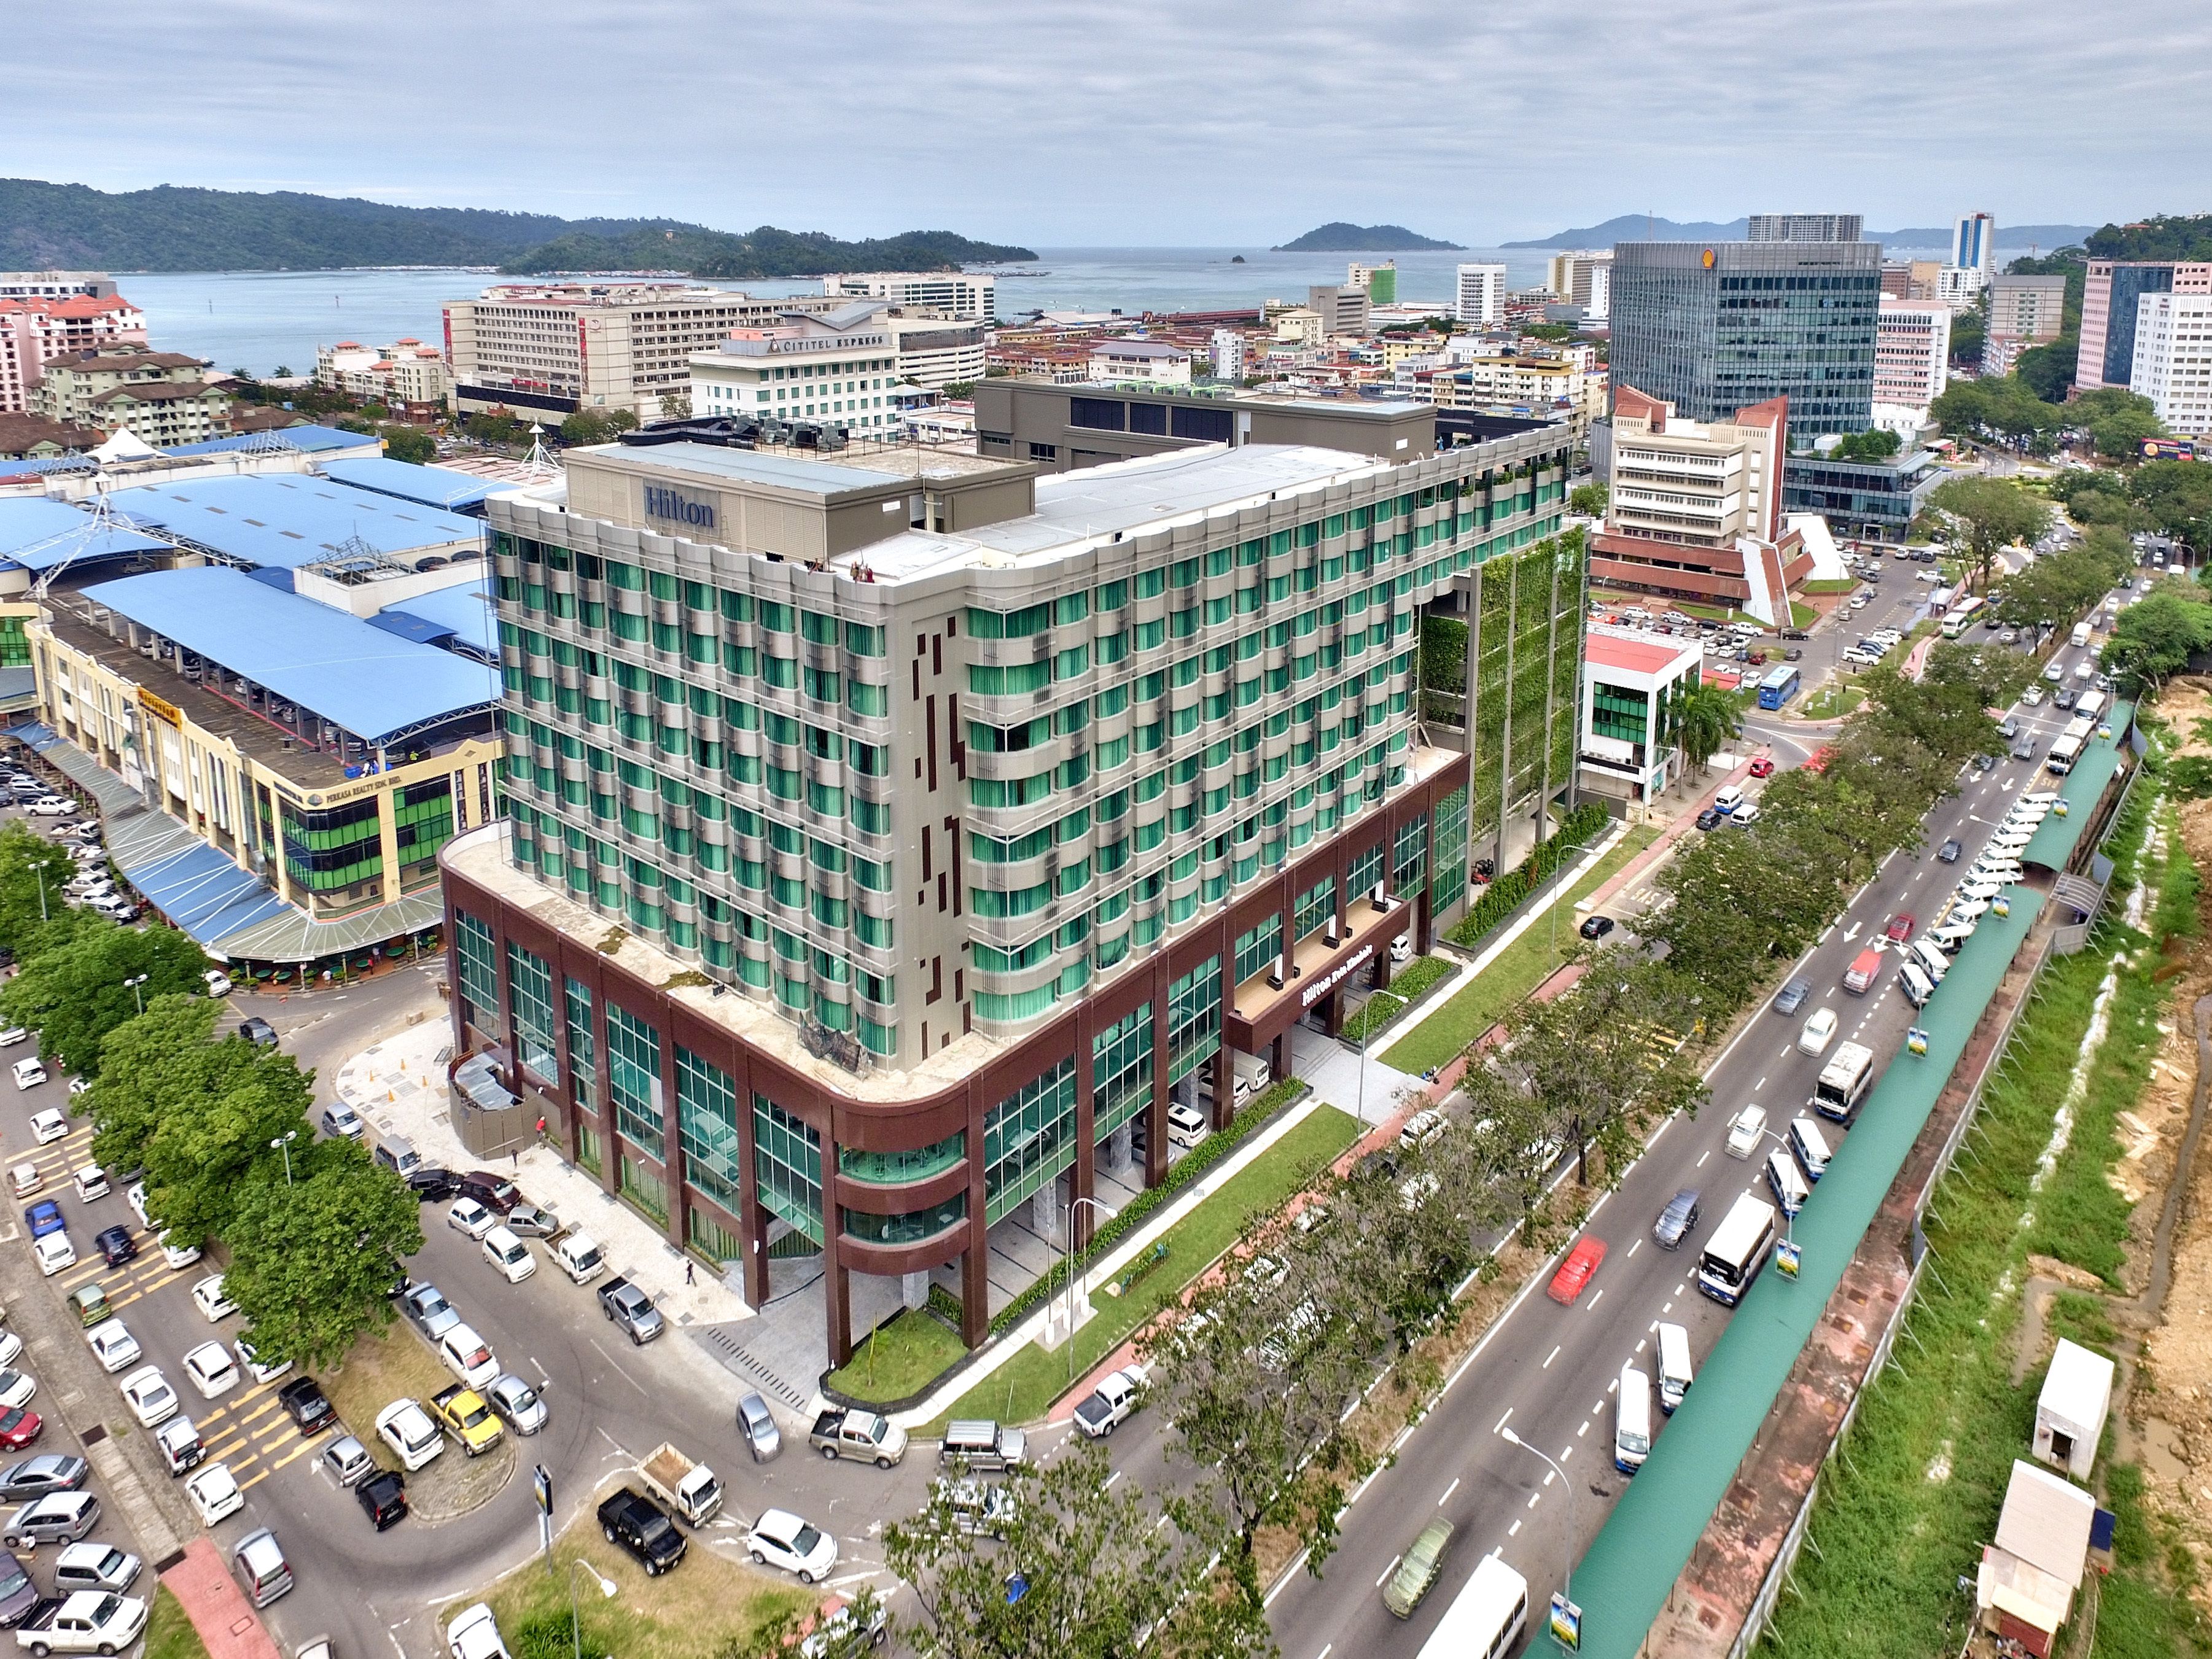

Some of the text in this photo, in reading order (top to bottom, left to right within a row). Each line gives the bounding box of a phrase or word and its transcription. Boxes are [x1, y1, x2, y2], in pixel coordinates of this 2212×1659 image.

[784, 336, 882, 351] CITITEL EXPRESS
[645, 486, 714, 528] Hilton
[327, 791, 352, 804] PERKASA
[352, 783, 373, 796] REALTY
[1630, 887, 1661, 905] BAS
[1302, 976, 1332, 1007] Hilton
[1331, 965, 1348, 984] Kota
